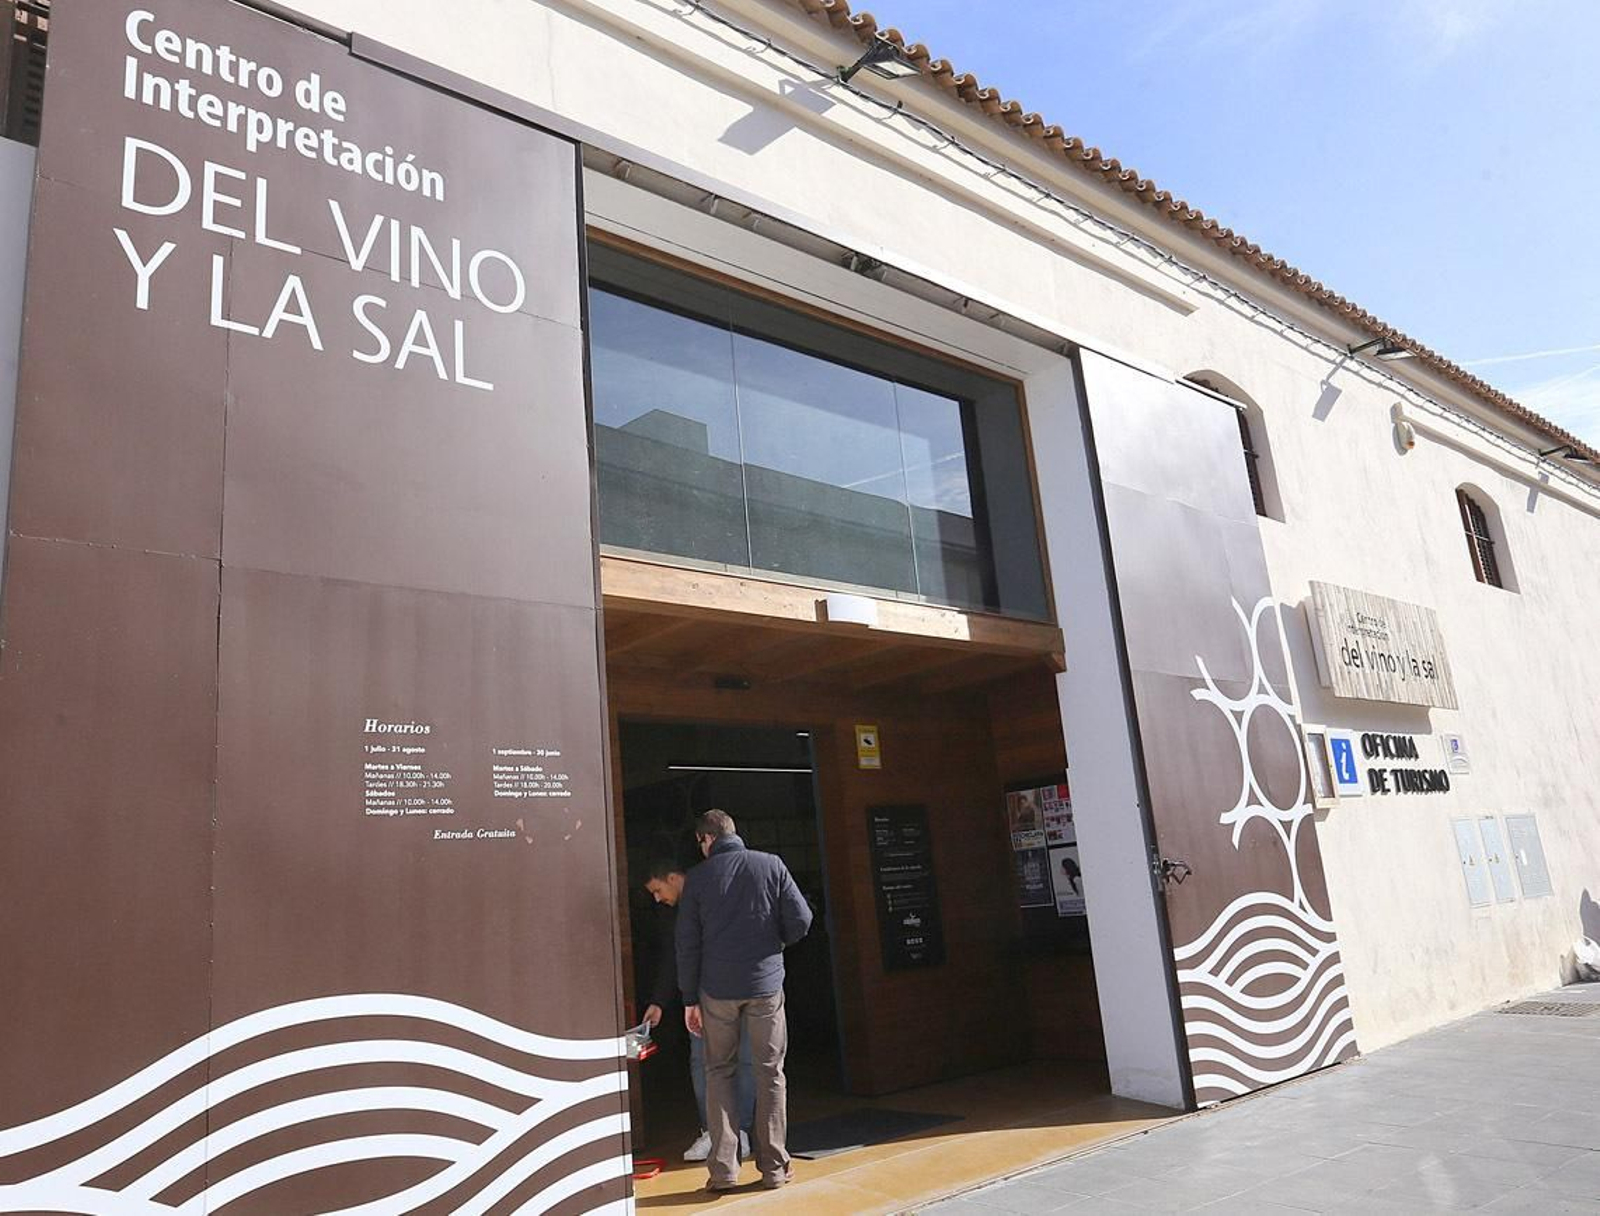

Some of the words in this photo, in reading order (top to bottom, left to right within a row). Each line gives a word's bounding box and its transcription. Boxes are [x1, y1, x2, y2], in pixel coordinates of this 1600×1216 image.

[125, 10, 283, 98] Centro
[295, 73, 346, 123] de
[124, 55, 445, 201] Interpretación
[121, 136, 301, 255] DEL
[328, 199, 525, 313] VINO
[113, 228, 176, 310] Y
[210, 254, 324, 351] LA
[352, 294, 494, 390] SAL
[1341, 637, 1364, 668] del
[1365, 645, 1396, 673] vino
[1397, 655, 1405, 681] y
[1406, 650, 1421, 677] la
[1422, 654, 1440, 680] sal
[363, 718, 431, 734] Horarios
[370, 745, 386, 754] julio
[402, 746, 425, 754] agosto
[1360, 732, 1419, 761] OFICINA
[1368, 768, 1390, 794] DE
[1390, 768, 1450, 794] TURISMO
[365, 798, 395, 806] Mañanas
[366, 808, 398, 817] Domingo
[433, 829, 473, 840] Entrada
[477, 828, 516, 839] Gratuita
